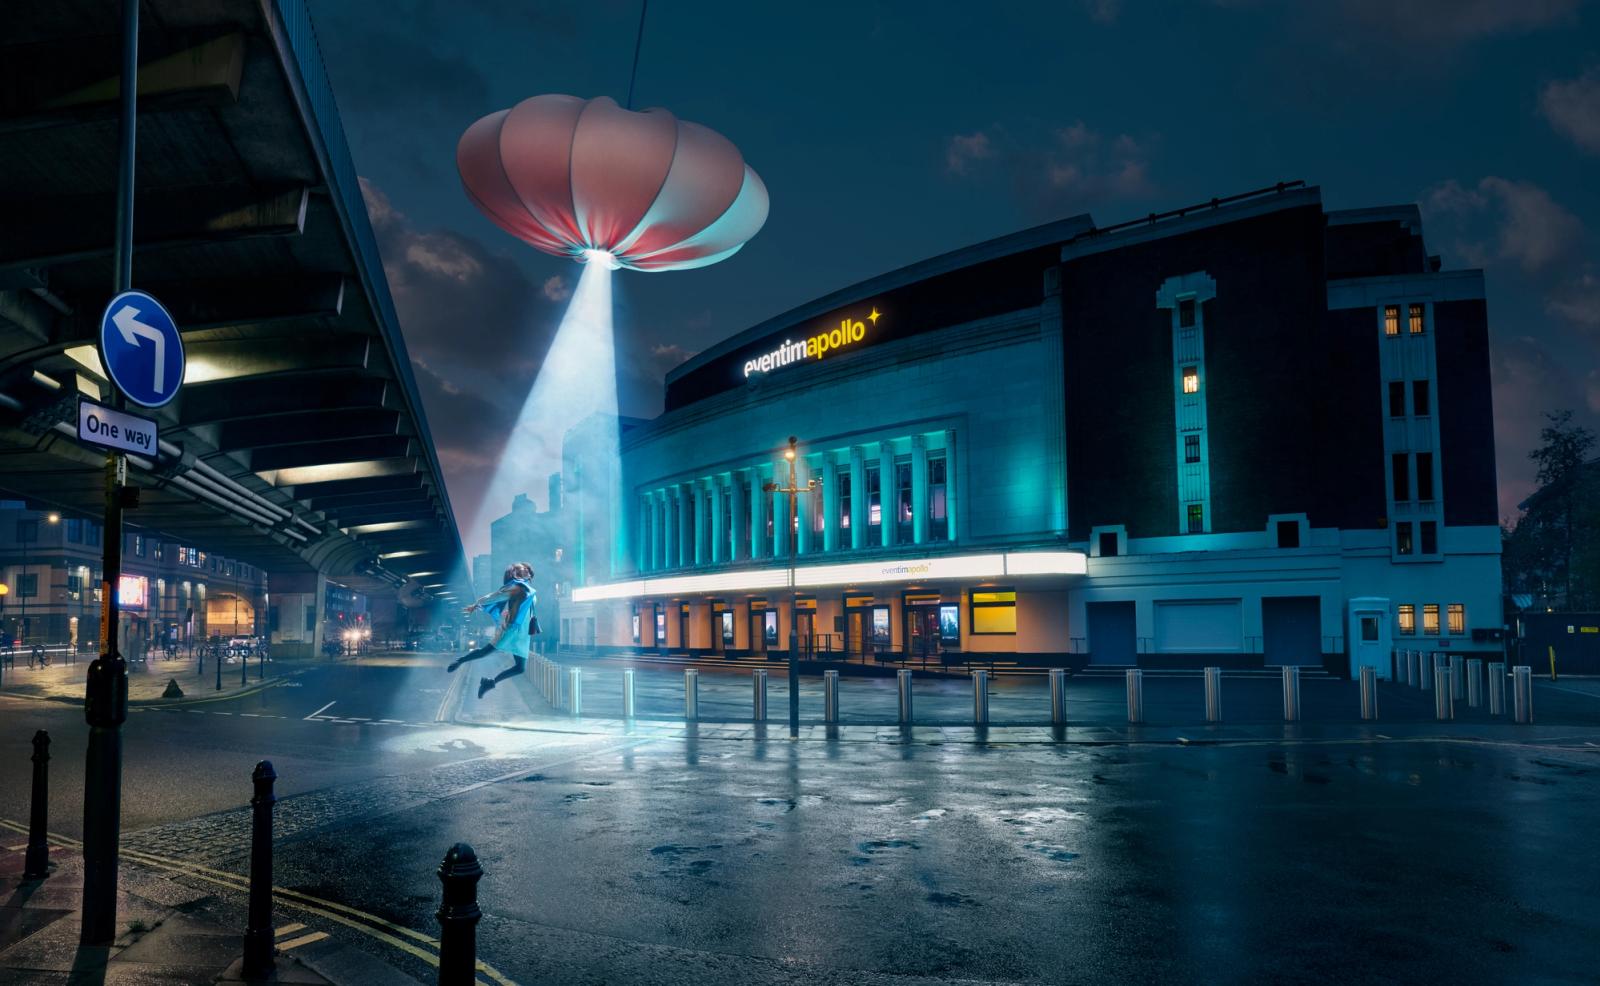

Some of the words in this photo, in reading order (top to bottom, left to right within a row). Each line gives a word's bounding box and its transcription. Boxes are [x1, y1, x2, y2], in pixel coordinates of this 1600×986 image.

[743, 318, 865, 377] eventimapollo
[87, 414, 118, 438] One
[125, 428, 151, 450] way
